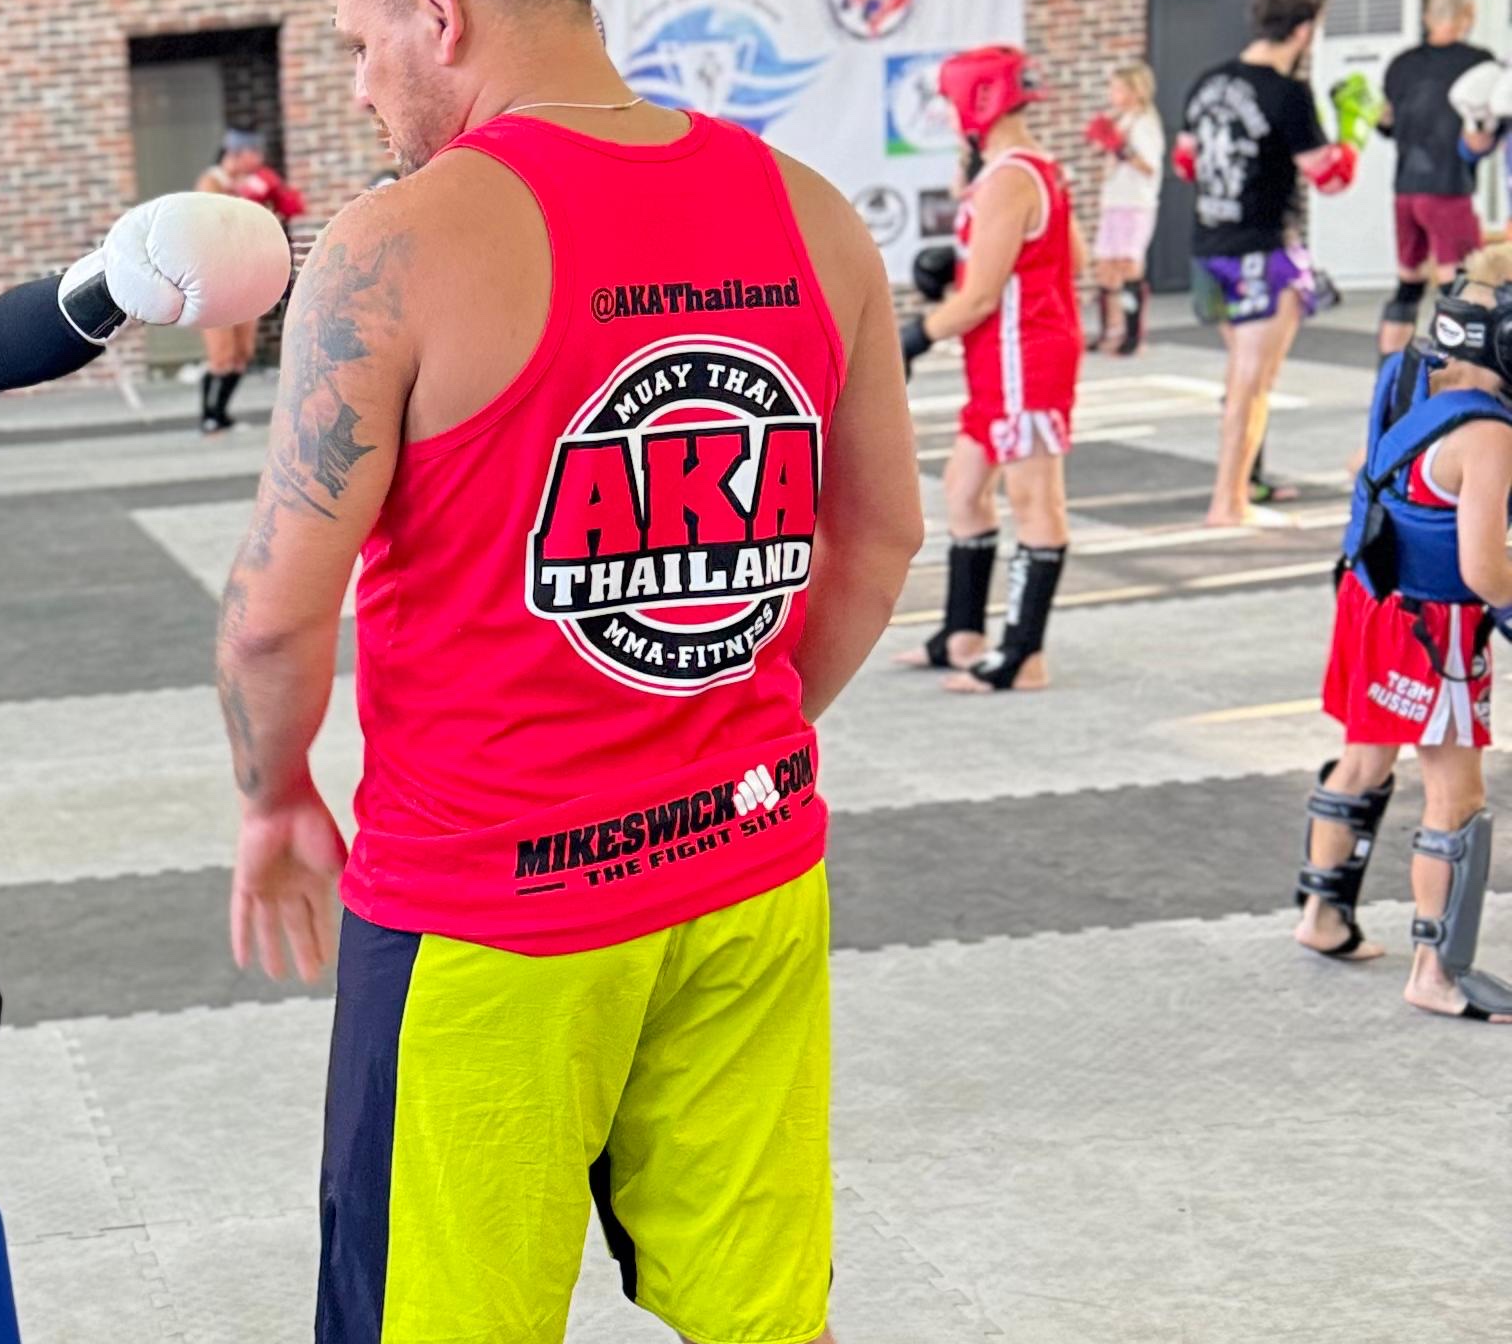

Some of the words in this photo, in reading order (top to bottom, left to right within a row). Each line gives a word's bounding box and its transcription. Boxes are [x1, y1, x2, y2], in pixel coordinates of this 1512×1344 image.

[591, 276, 800, 323] @AKAThailand
[614, 363, 693, 424] MUAY
[706, 363, 779, 411] THAI
[541, 428, 817, 561] AKA
[541, 541, 811, 607] THAILAND
[584, 858, 642, 887] THE
[649, 828, 732, 869] FIGHT
[739, 806, 792, 839] SITE
